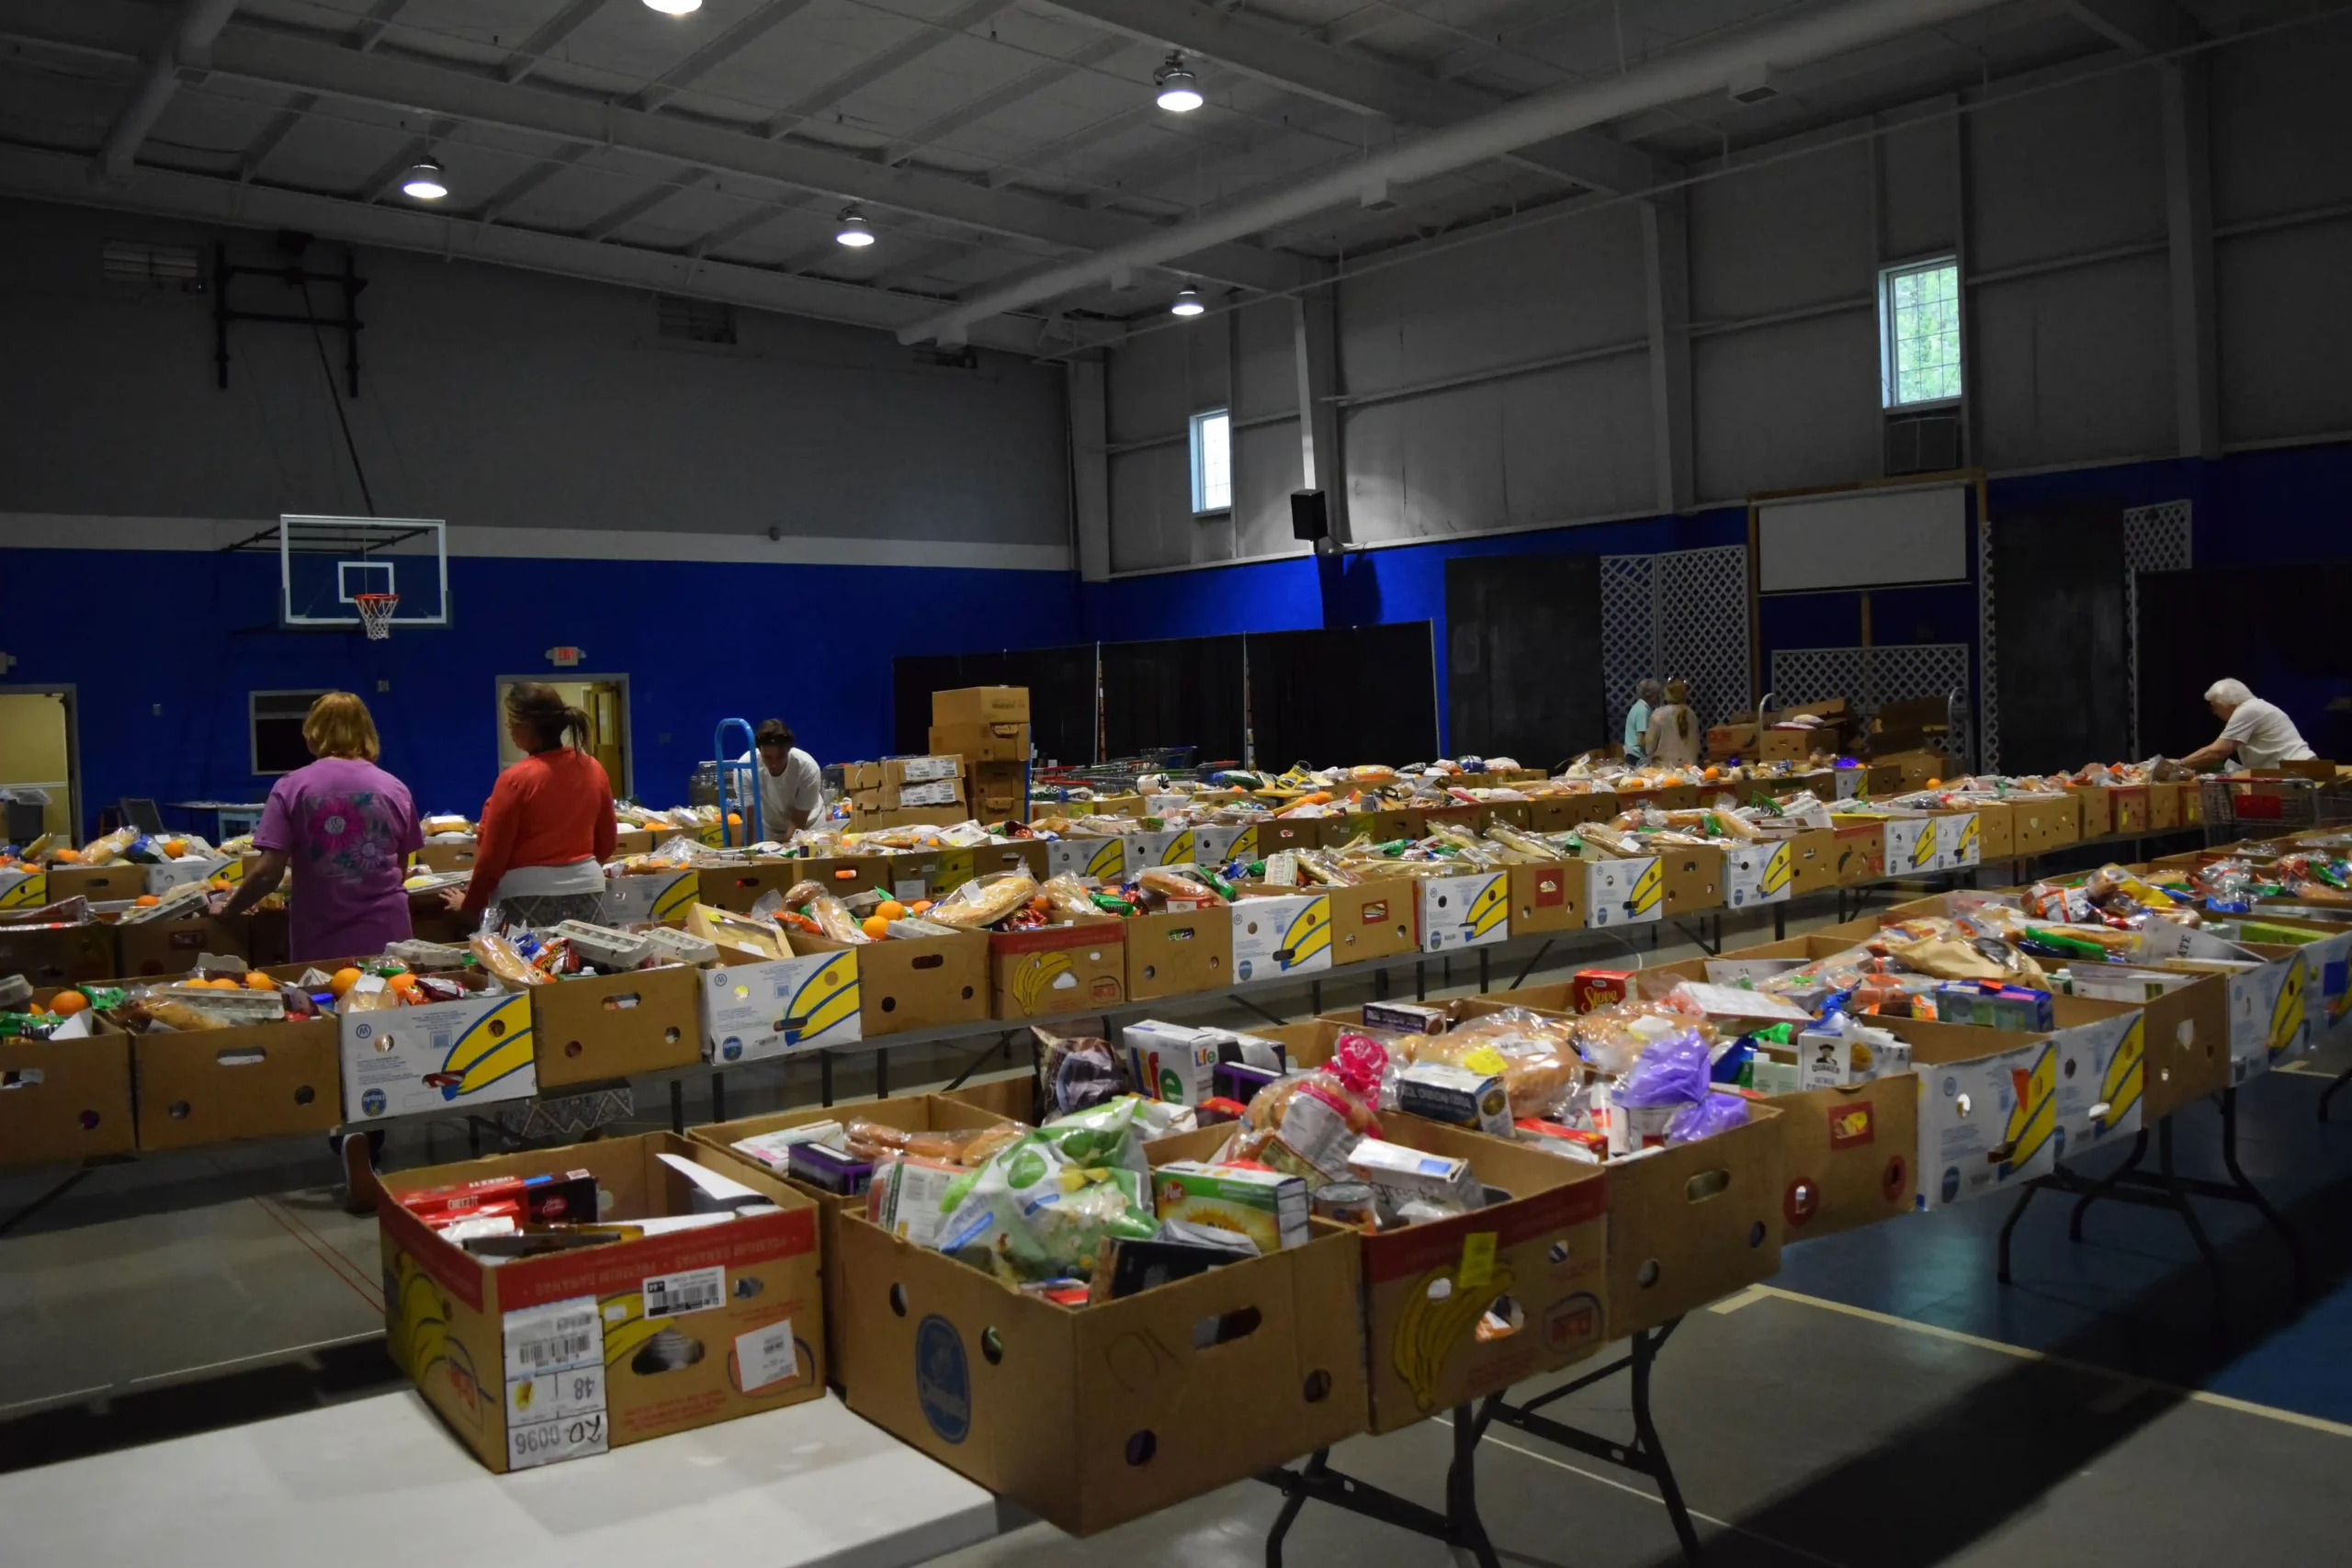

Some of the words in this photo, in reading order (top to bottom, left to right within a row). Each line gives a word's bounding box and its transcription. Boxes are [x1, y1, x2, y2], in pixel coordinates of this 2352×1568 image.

[1194, 1047, 1216, 1066] Life
[1131, 1046, 1183, 1106] Life
[1812, 1064, 1840, 1074] QUAKER
[574, 1377, 595, 1401] 48
[515, 1426, 562, 1456] 0096
